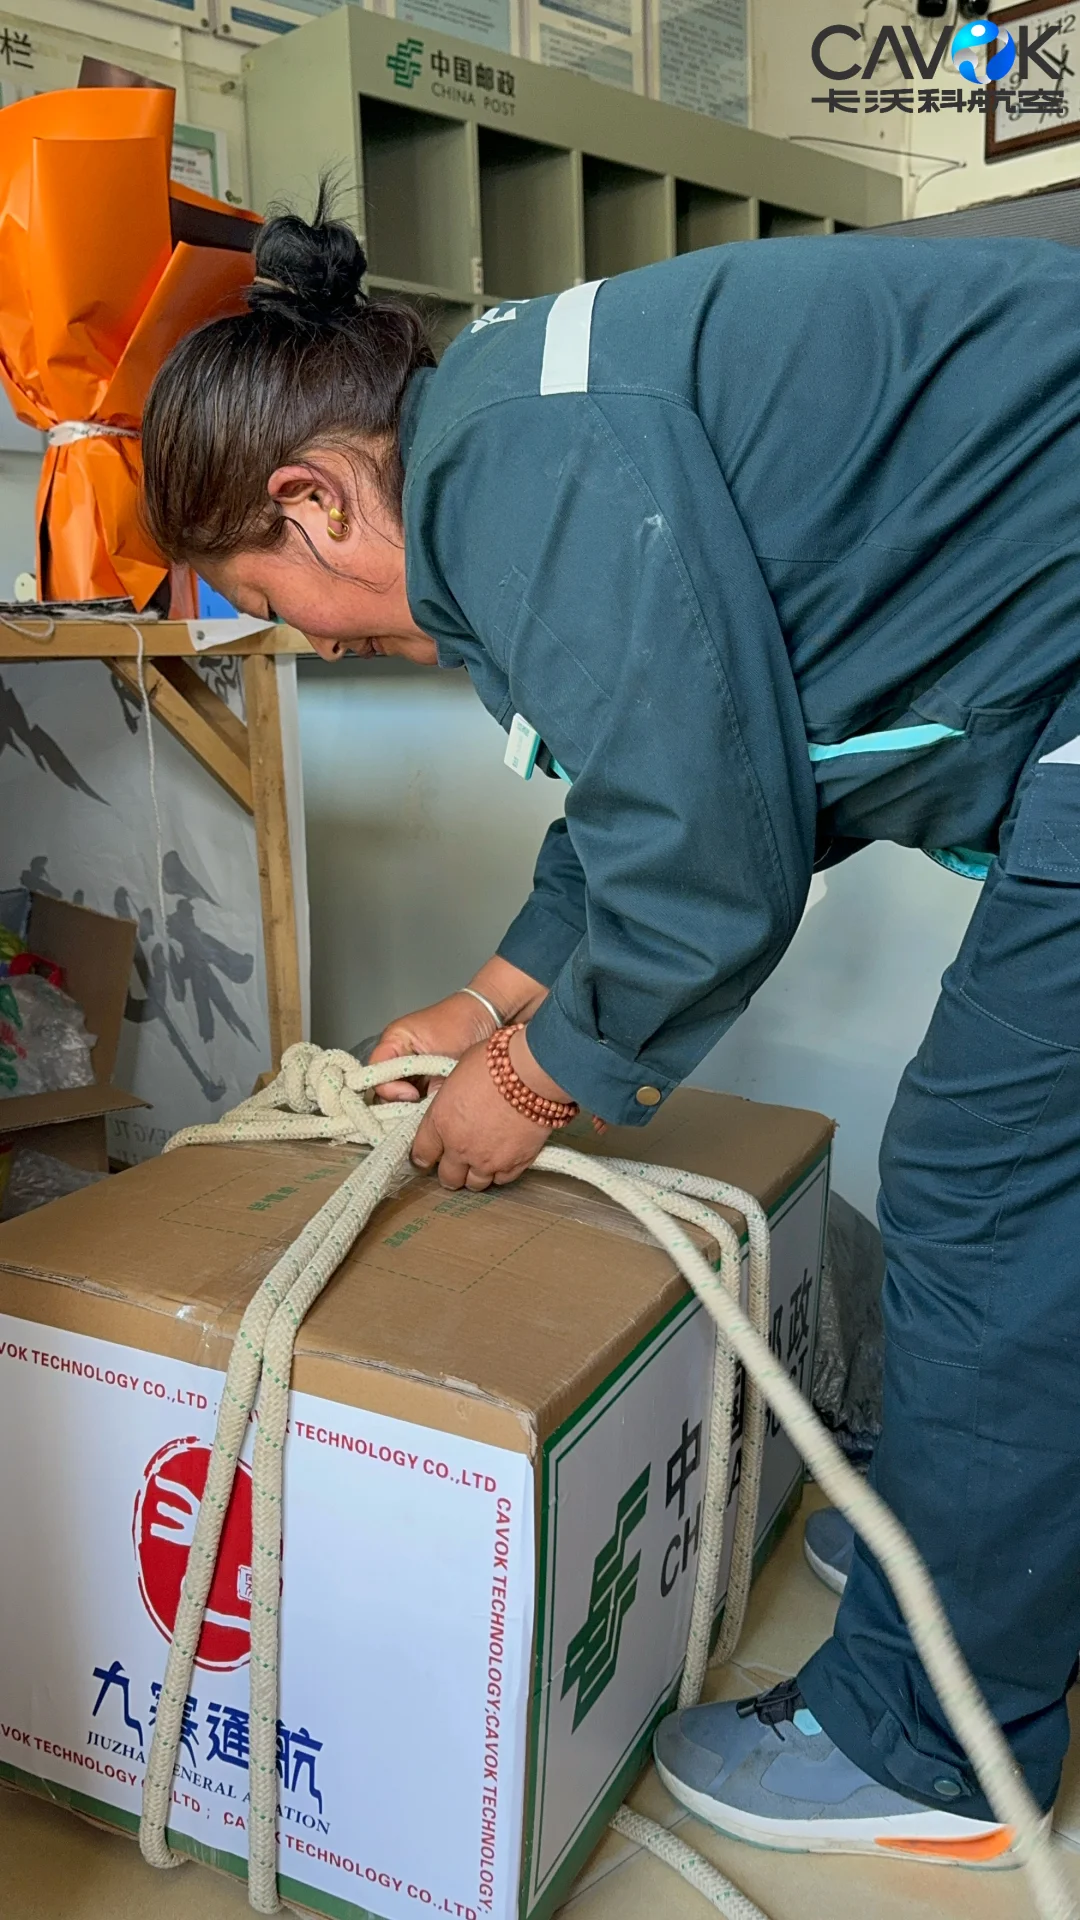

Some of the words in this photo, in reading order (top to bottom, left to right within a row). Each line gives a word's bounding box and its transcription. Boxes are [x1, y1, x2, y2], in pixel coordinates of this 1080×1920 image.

[0, 28, 34, 69] 栏
[431, 50, 516, 98] 中国邮政
[431, 82, 476, 107] CHINA
[484, 97, 516, 117] POST
[31, 1349, 139, 1391] TECHNOLOGY
[143, 1380, 208, 1410] CO.,LTD
[295, 1420, 418, 1470] TECHNOLOGY
[423, 1458, 497, 1493] CO.,LTD
[493, 1497, 511, 1571] CAVOK
[87, 1730, 146, 1765] JIUZHA
[173, 1762, 237, 1800] ENERAL
[242, 1791, 331, 1836] AATION
[34, 1736, 138, 1787] TECHNOLOGY
[223, 1811, 281, 1845] CAK
[285, 1833, 402, 1892] TECHNOLOGY
[406, 1884, 478, 1920] CO.,LTD
